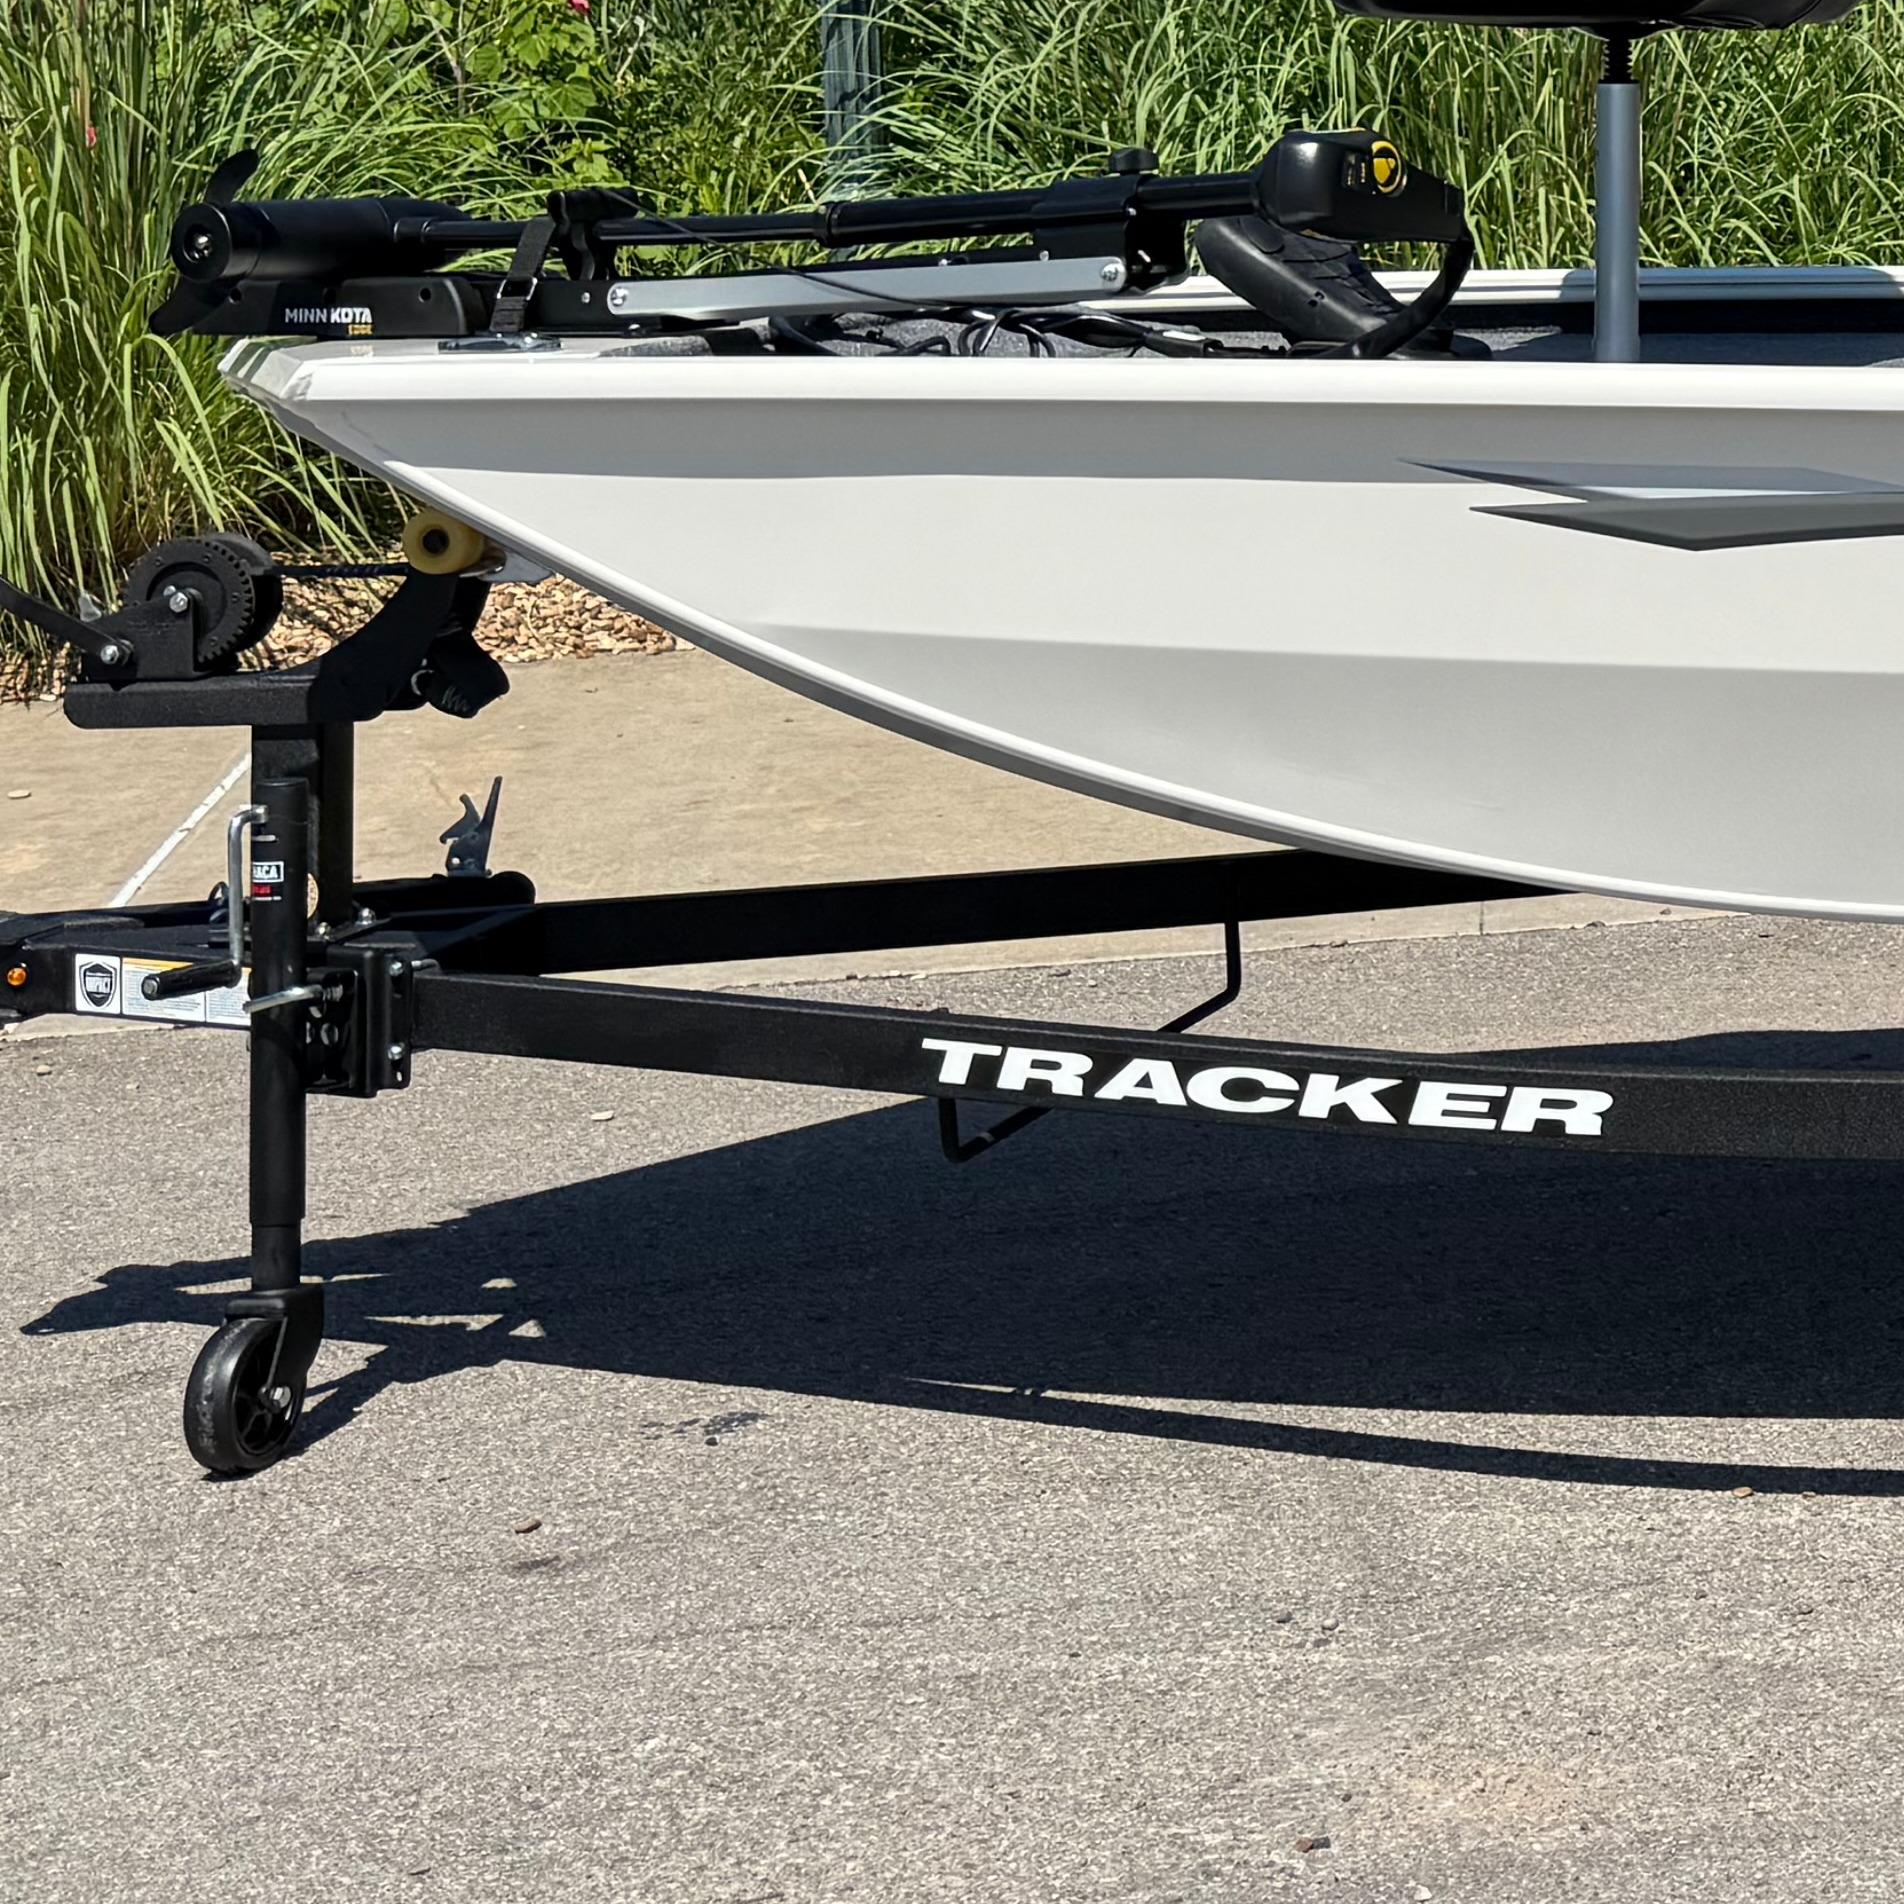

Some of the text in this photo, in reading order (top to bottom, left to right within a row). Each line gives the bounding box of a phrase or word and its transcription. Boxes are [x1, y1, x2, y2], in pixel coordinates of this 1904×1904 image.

[284, 306, 373, 324] MINN KOTA
[921, 1037, 1616, 1137] TRACKER
